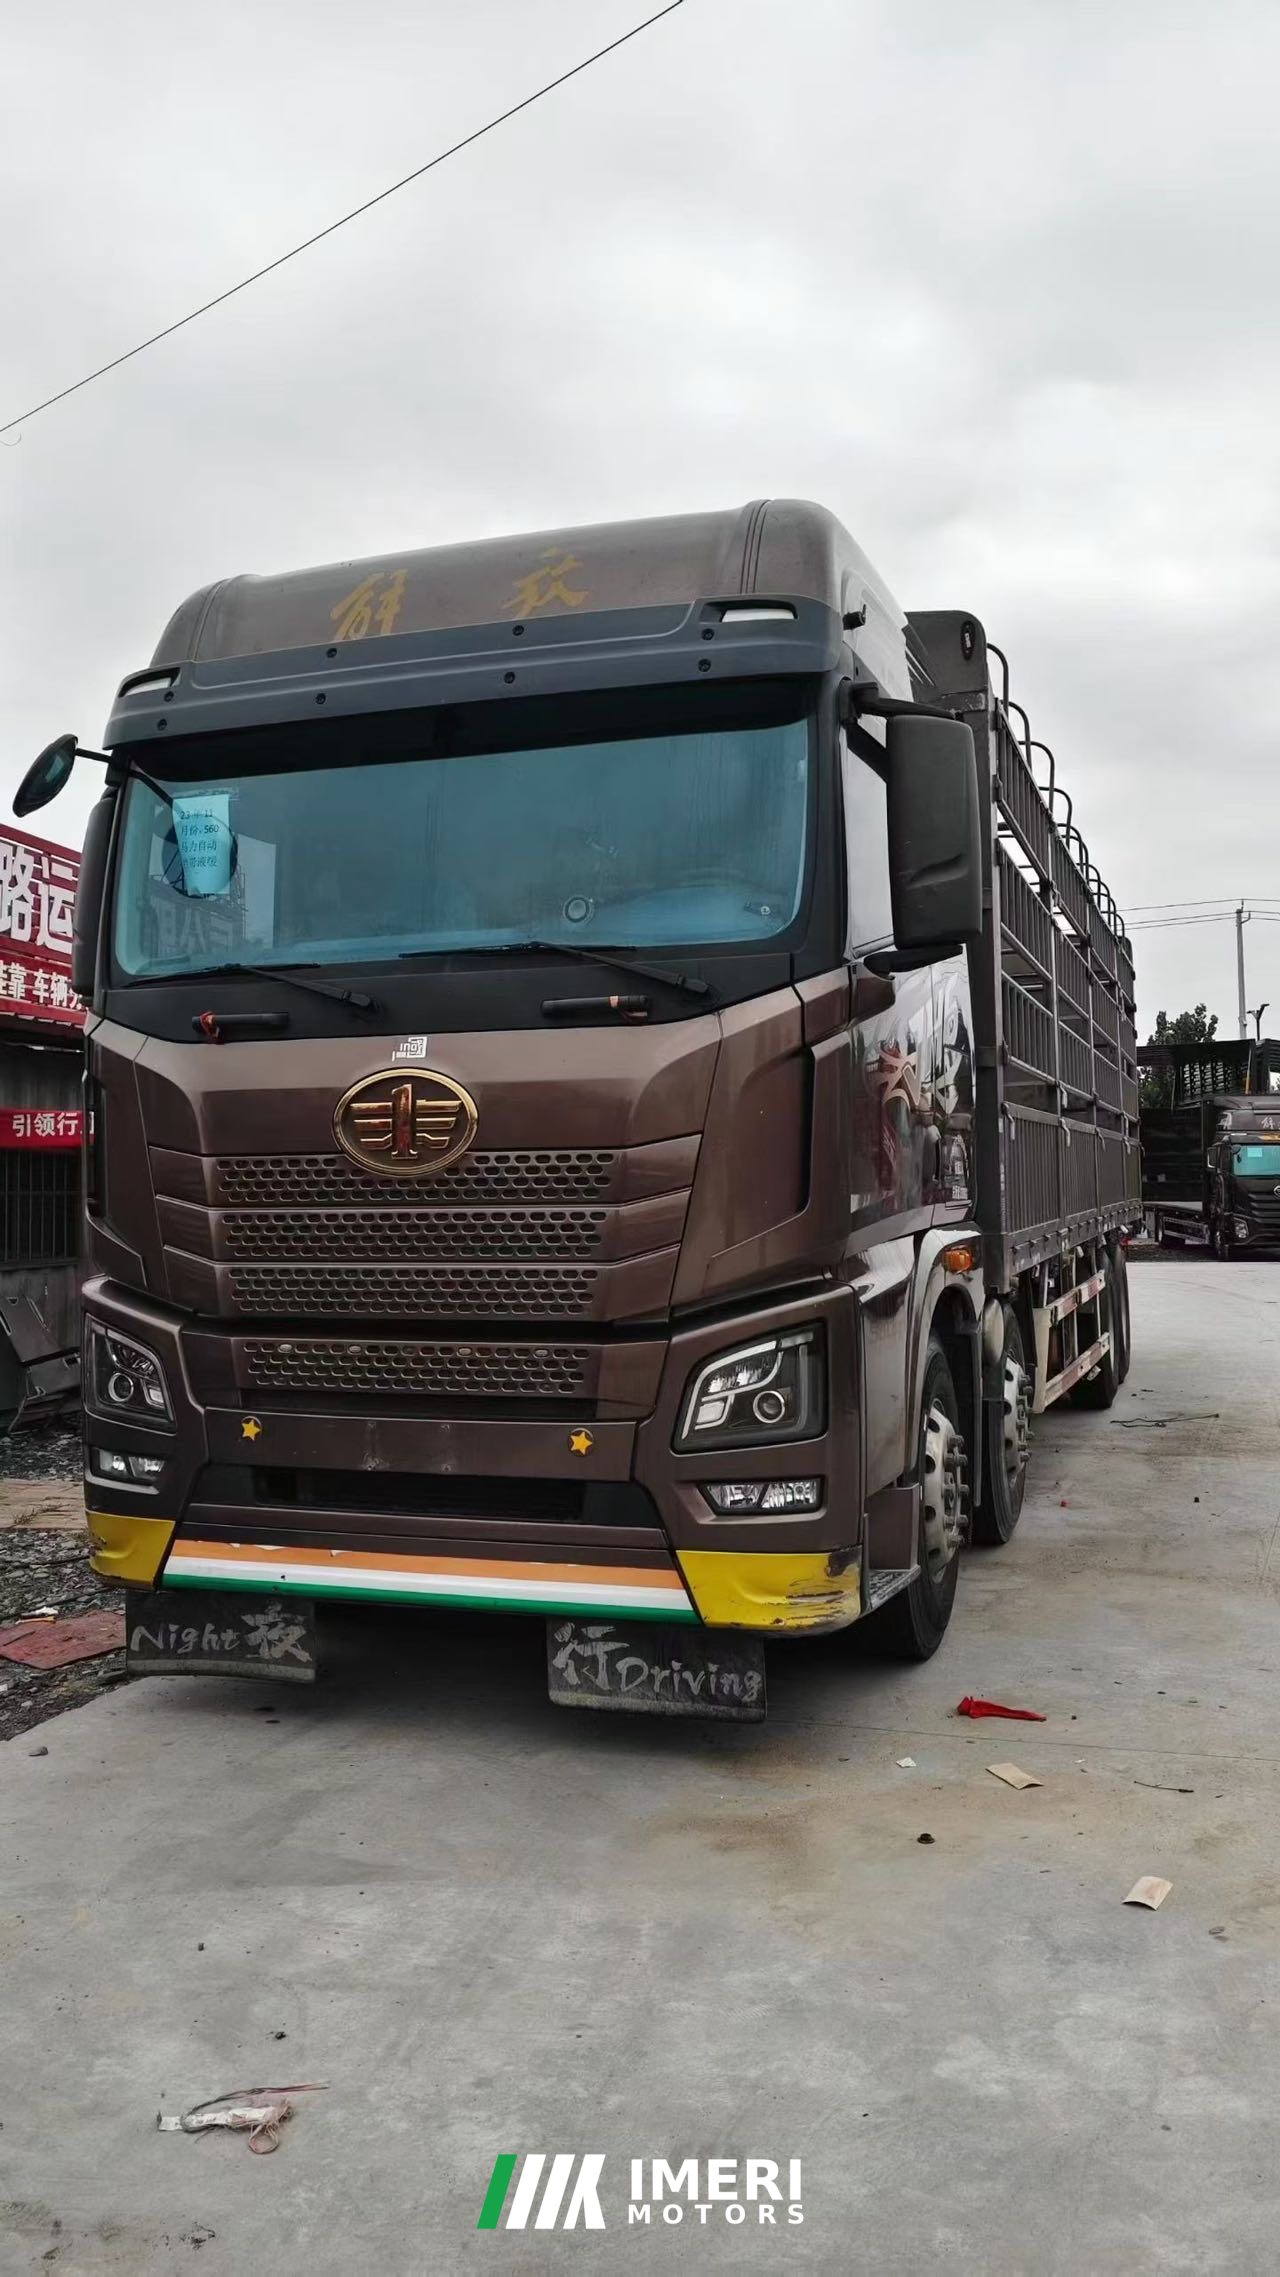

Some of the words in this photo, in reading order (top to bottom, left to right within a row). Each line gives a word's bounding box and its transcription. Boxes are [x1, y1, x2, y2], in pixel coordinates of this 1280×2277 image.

[130, 1623, 240, 1654] Night
[552, 1622, 630, 1690] 行
[615, 1656, 762, 1701] Driving
